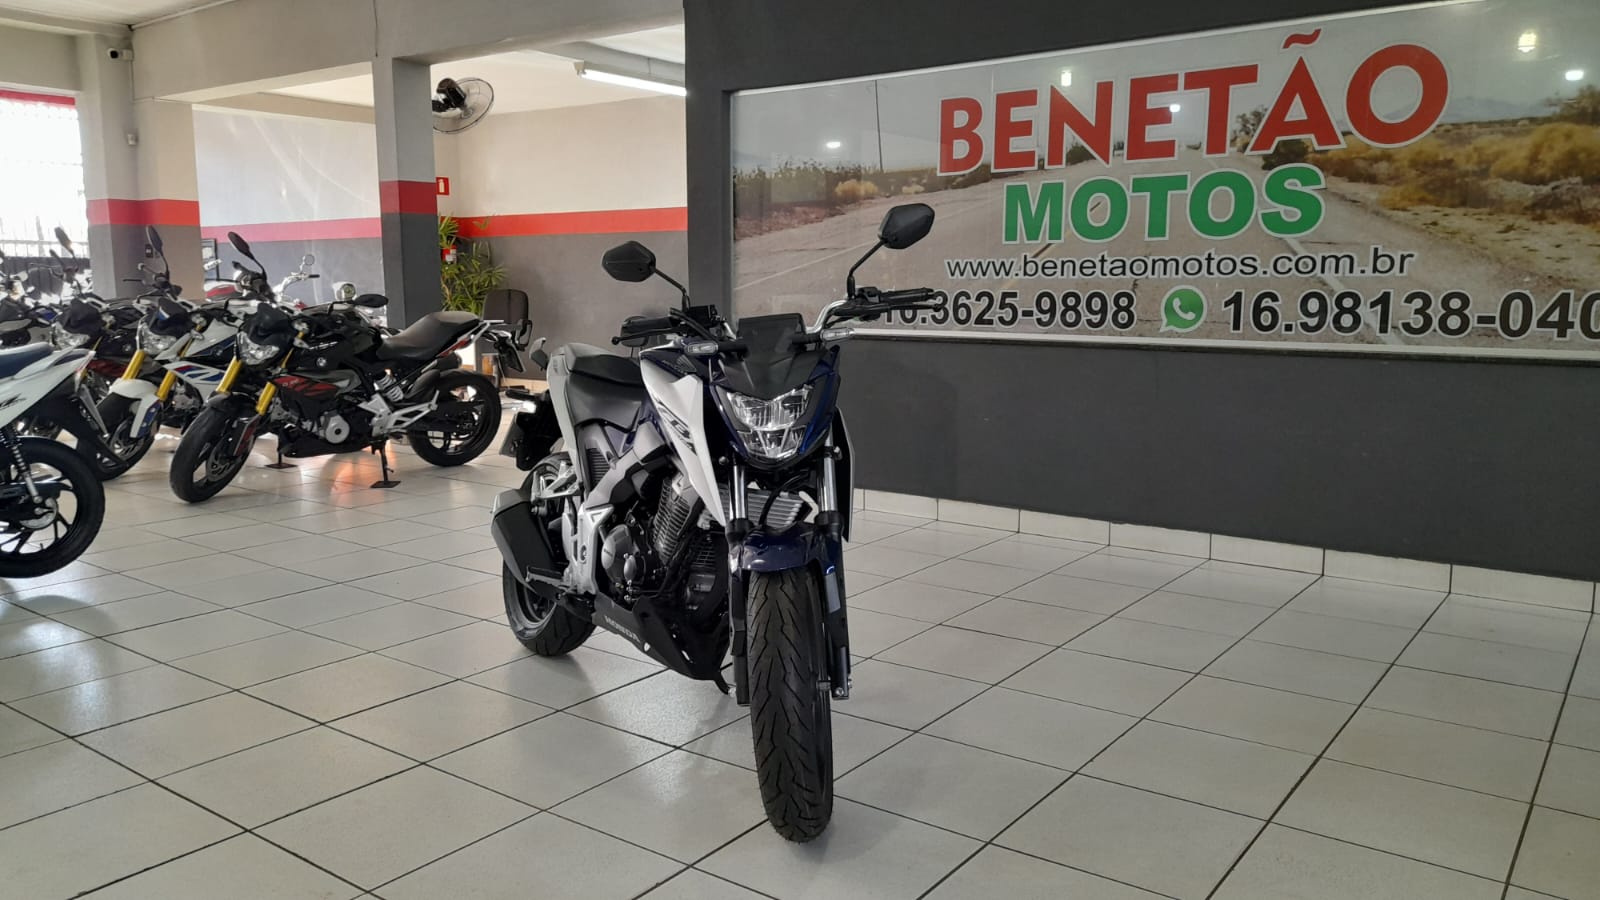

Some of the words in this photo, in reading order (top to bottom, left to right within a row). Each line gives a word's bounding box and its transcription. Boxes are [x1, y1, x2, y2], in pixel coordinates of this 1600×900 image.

[938, 29, 1448, 174] BENETÃO
[1003, 165, 1325, 242] MOTOS
[946, 246, 1415, 278] www.benetaomotos.com.br
[1222, 290, 1600, 341] 16.98138-040
